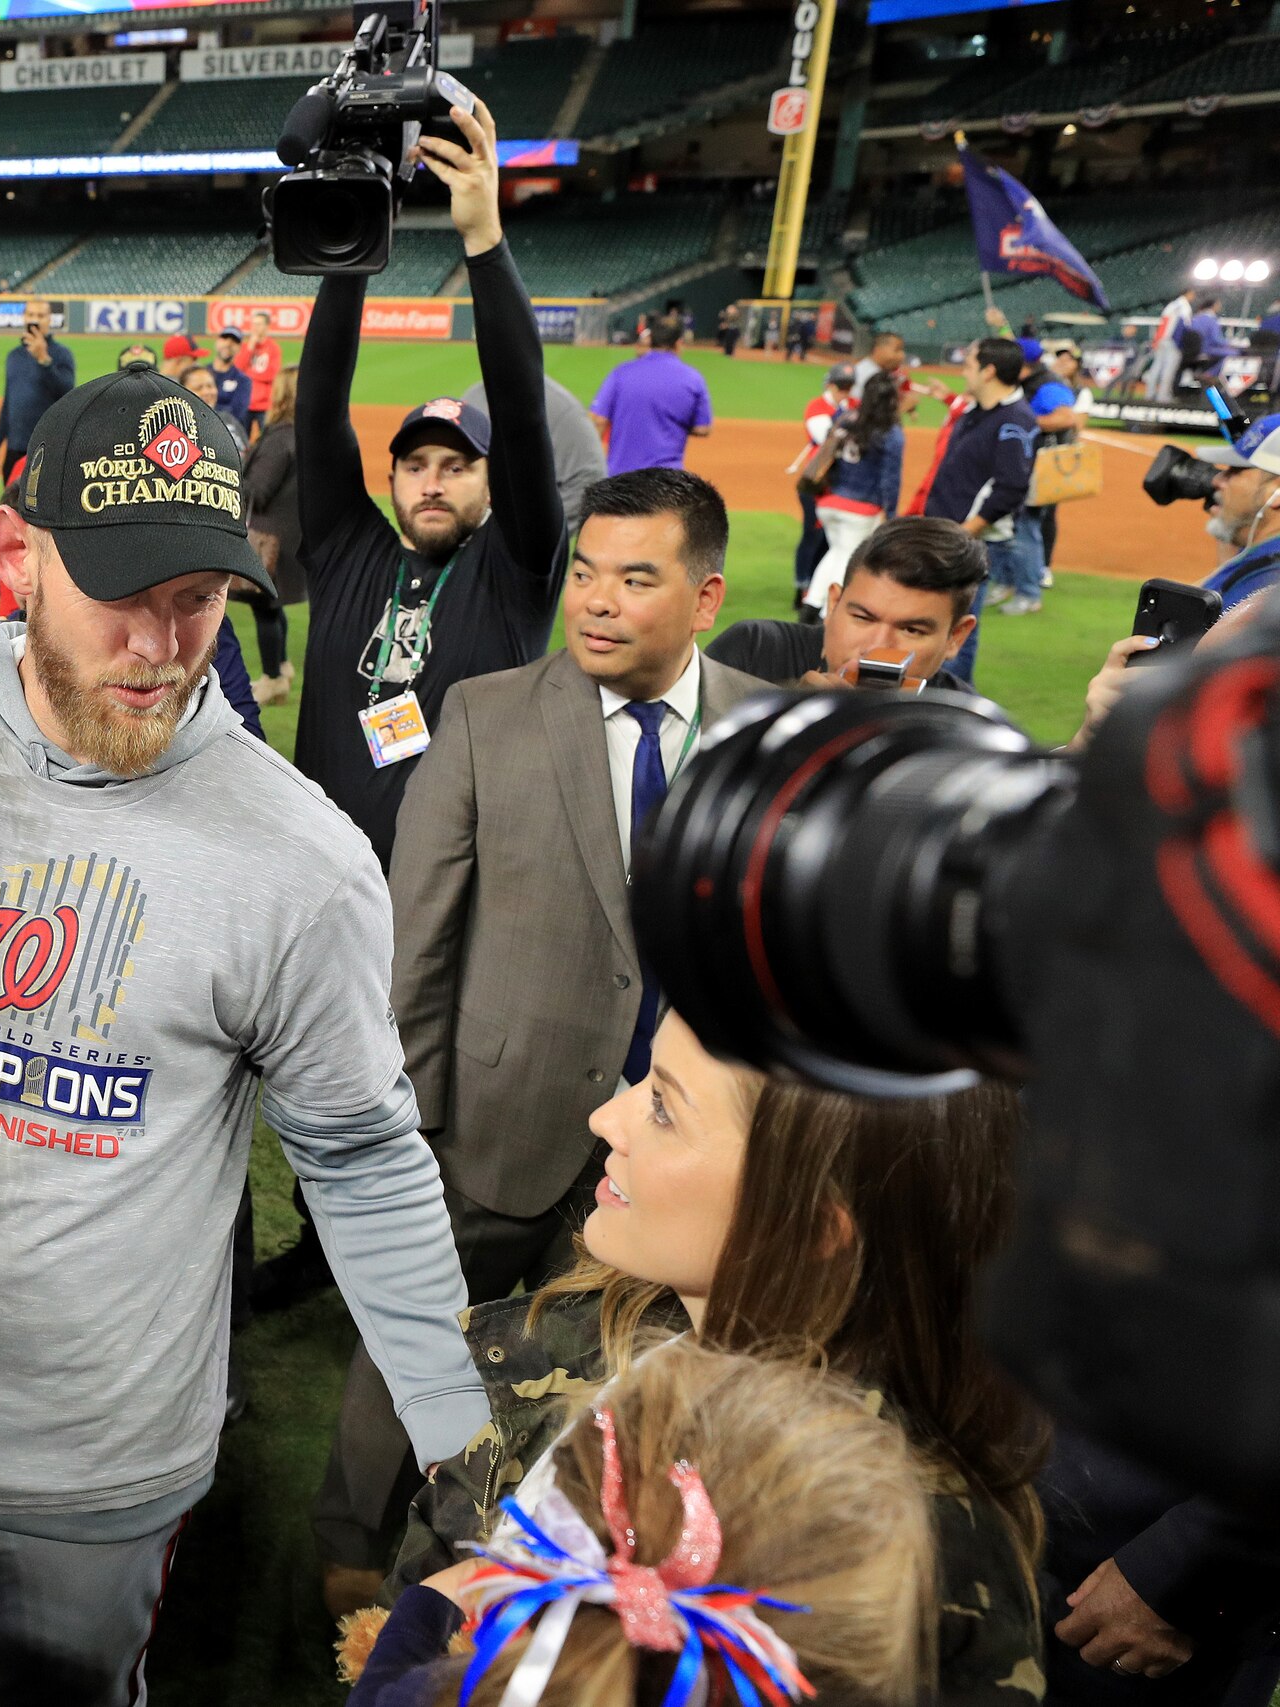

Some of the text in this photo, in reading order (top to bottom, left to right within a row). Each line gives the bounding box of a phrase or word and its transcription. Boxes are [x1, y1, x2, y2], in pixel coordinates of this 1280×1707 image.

[789, 0, 819, 85] OUL
[15, 58, 147, 85] CHEVROLET
[204, 49, 345, 75] SILVERADO
[88, 301, 185, 332] RTIC
[114, 443, 216, 459] 20 19
[156, 437, 188, 467] W
[80, 457, 240, 488] WORLD SERIES
[80, 477, 241, 520] CHAMPIONS
[51, 1040, 144, 1066] SERIES
